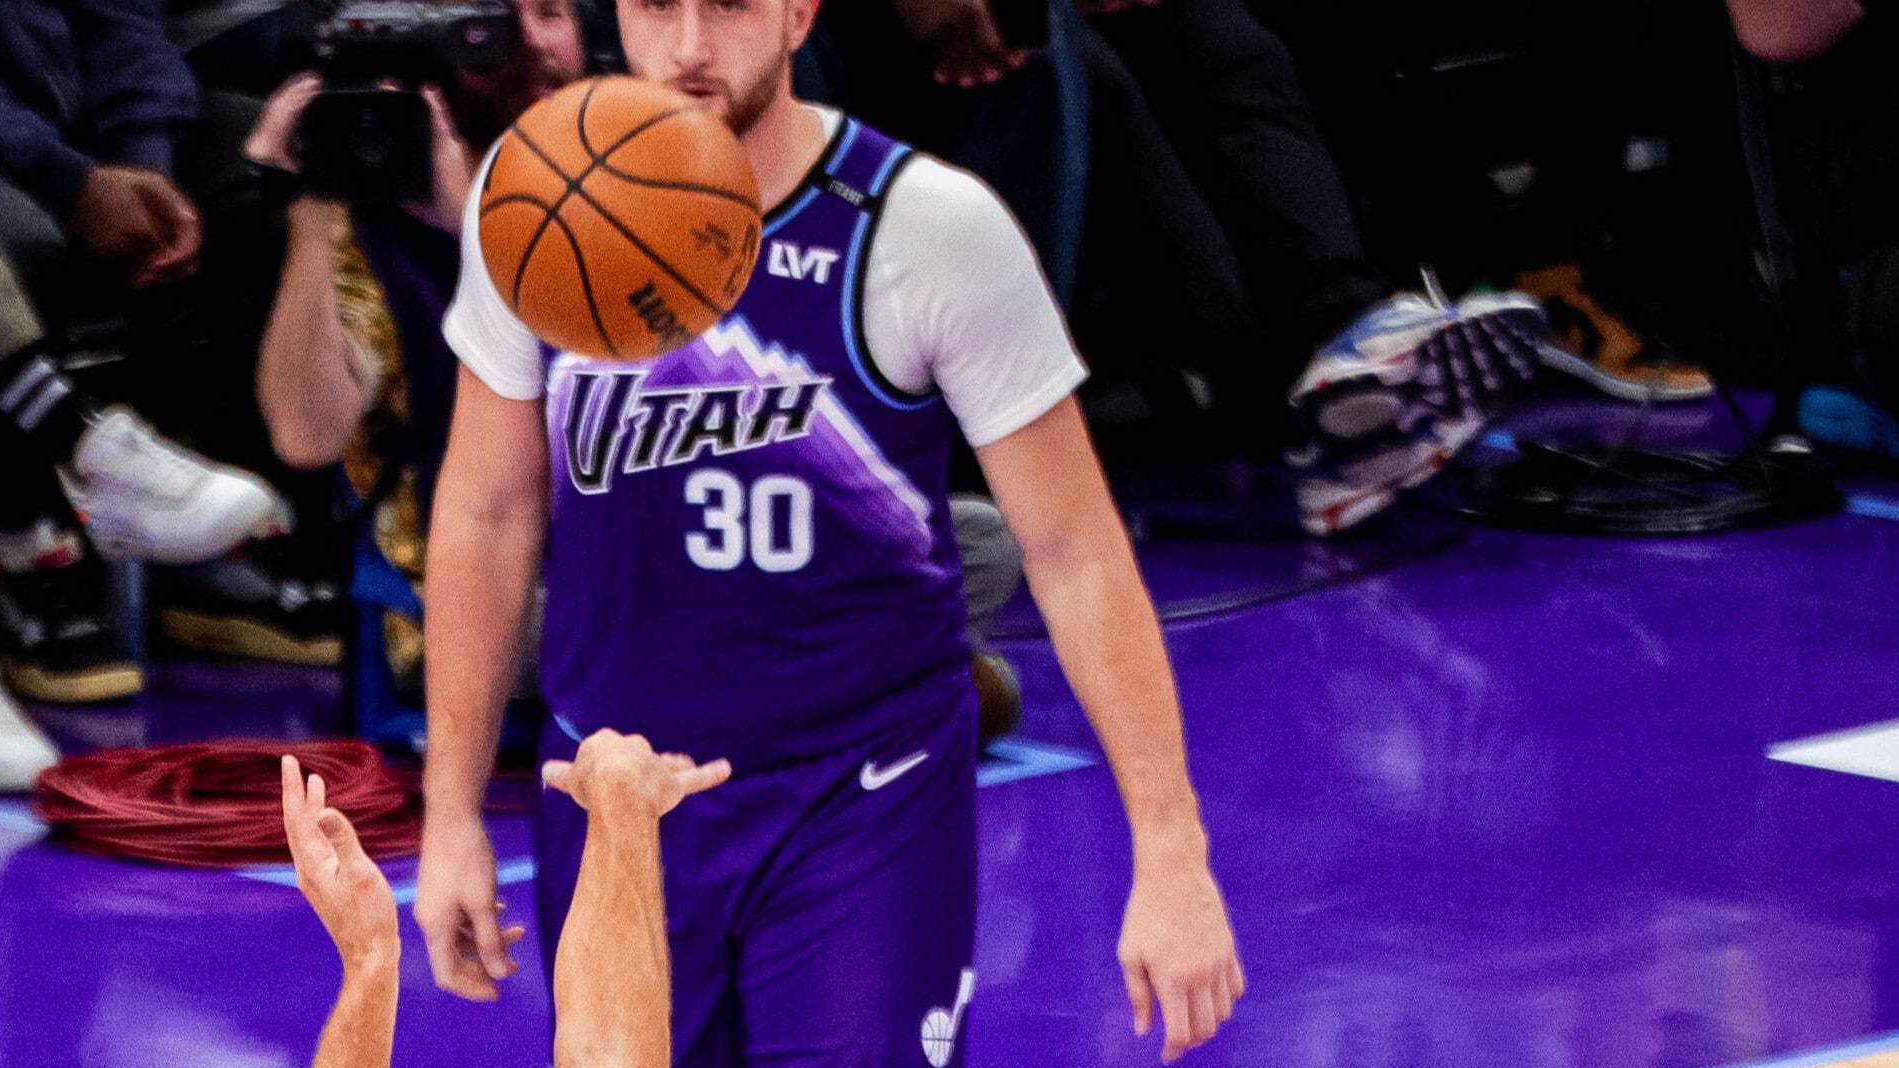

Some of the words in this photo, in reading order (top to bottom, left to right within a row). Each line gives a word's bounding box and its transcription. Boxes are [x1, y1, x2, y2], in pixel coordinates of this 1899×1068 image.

[767, 240, 841, 285] LVT
[564, 369, 834, 495] UTAH
[684, 468, 814, 573] 30
